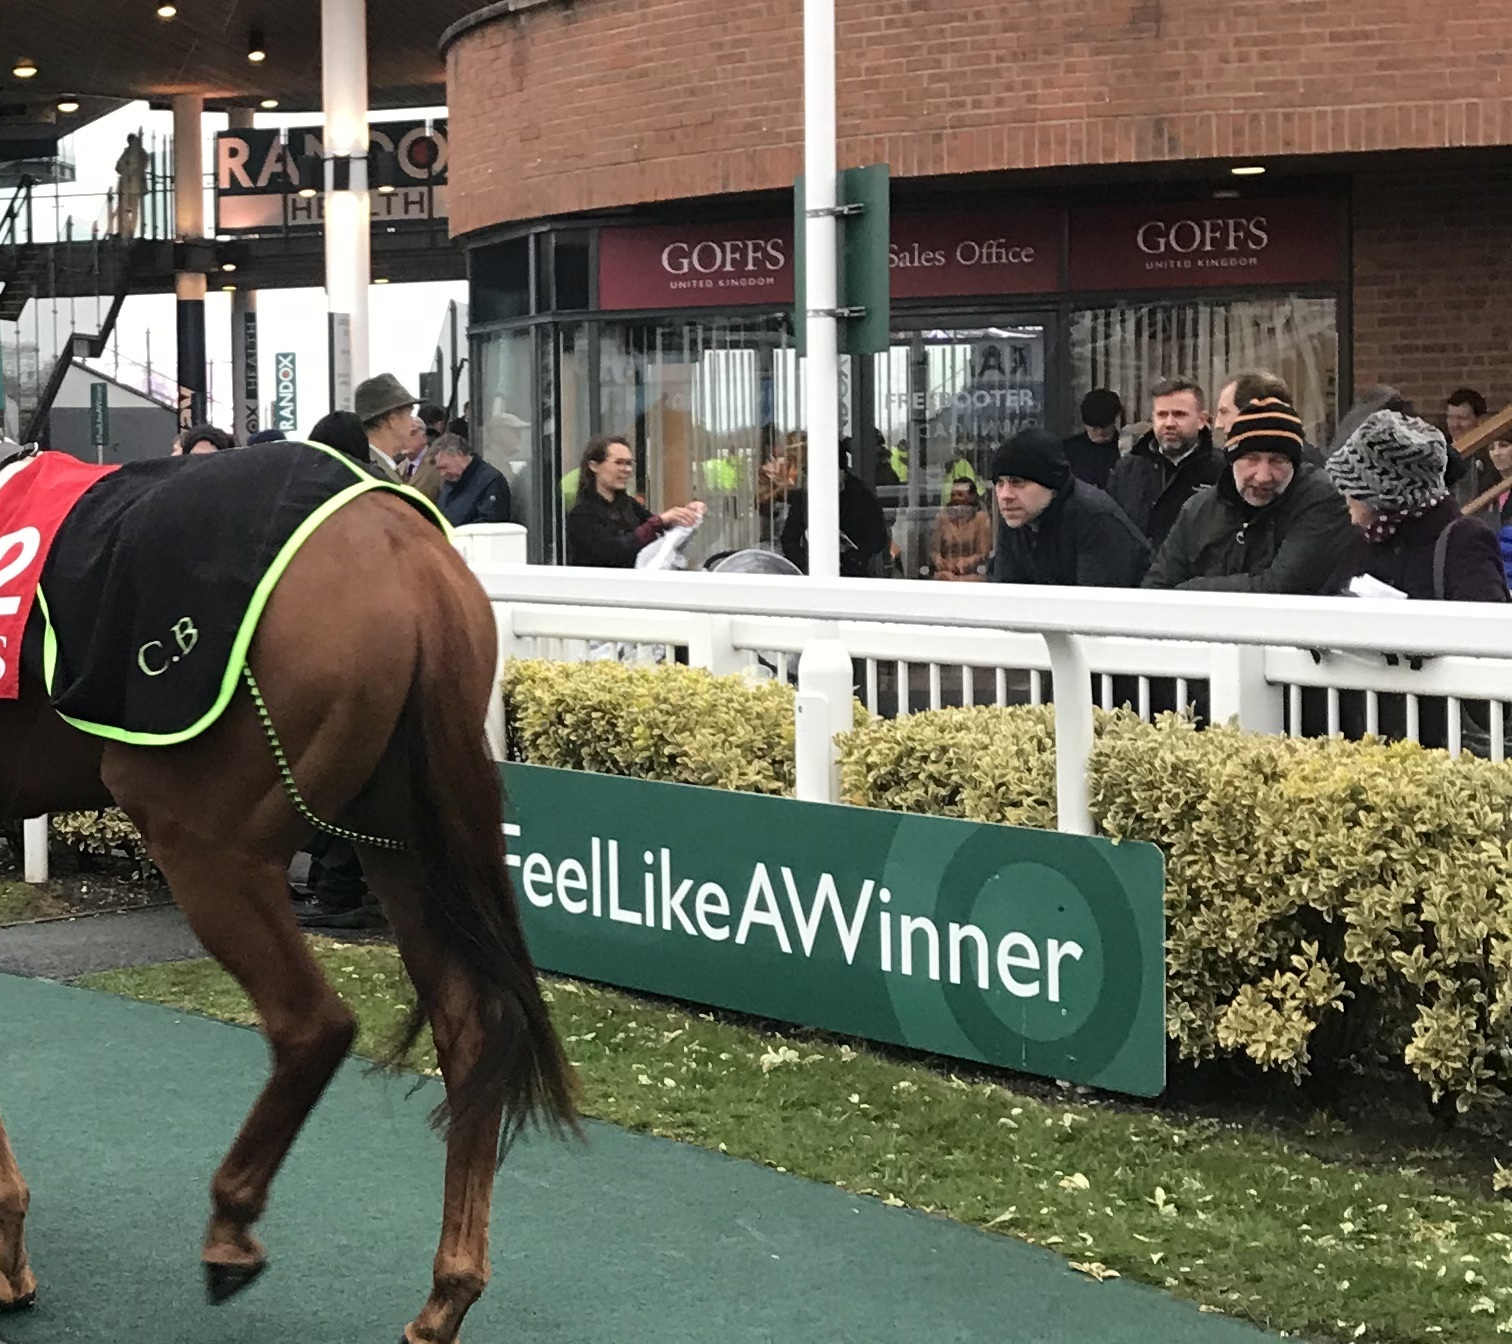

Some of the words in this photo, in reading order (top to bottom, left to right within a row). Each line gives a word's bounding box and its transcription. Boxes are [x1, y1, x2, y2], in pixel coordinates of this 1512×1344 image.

[218, 128, 448, 189] RAO
[292, 192, 425, 221] HTH
[1137, 216, 1269, 253] GOFFS
[661, 238, 785, 274] GOFFS
[888, 243, 946, 268] Sales
[956, 238, 1035, 265] Office
[1145, 260, 1191, 270] UNITED
[1197, 257, 1258, 268] KINGDOM
[670, 279, 714, 289] UNITED
[718, 277, 775, 287] KINGDOM
[279, 354, 294, 431] RANDOX
